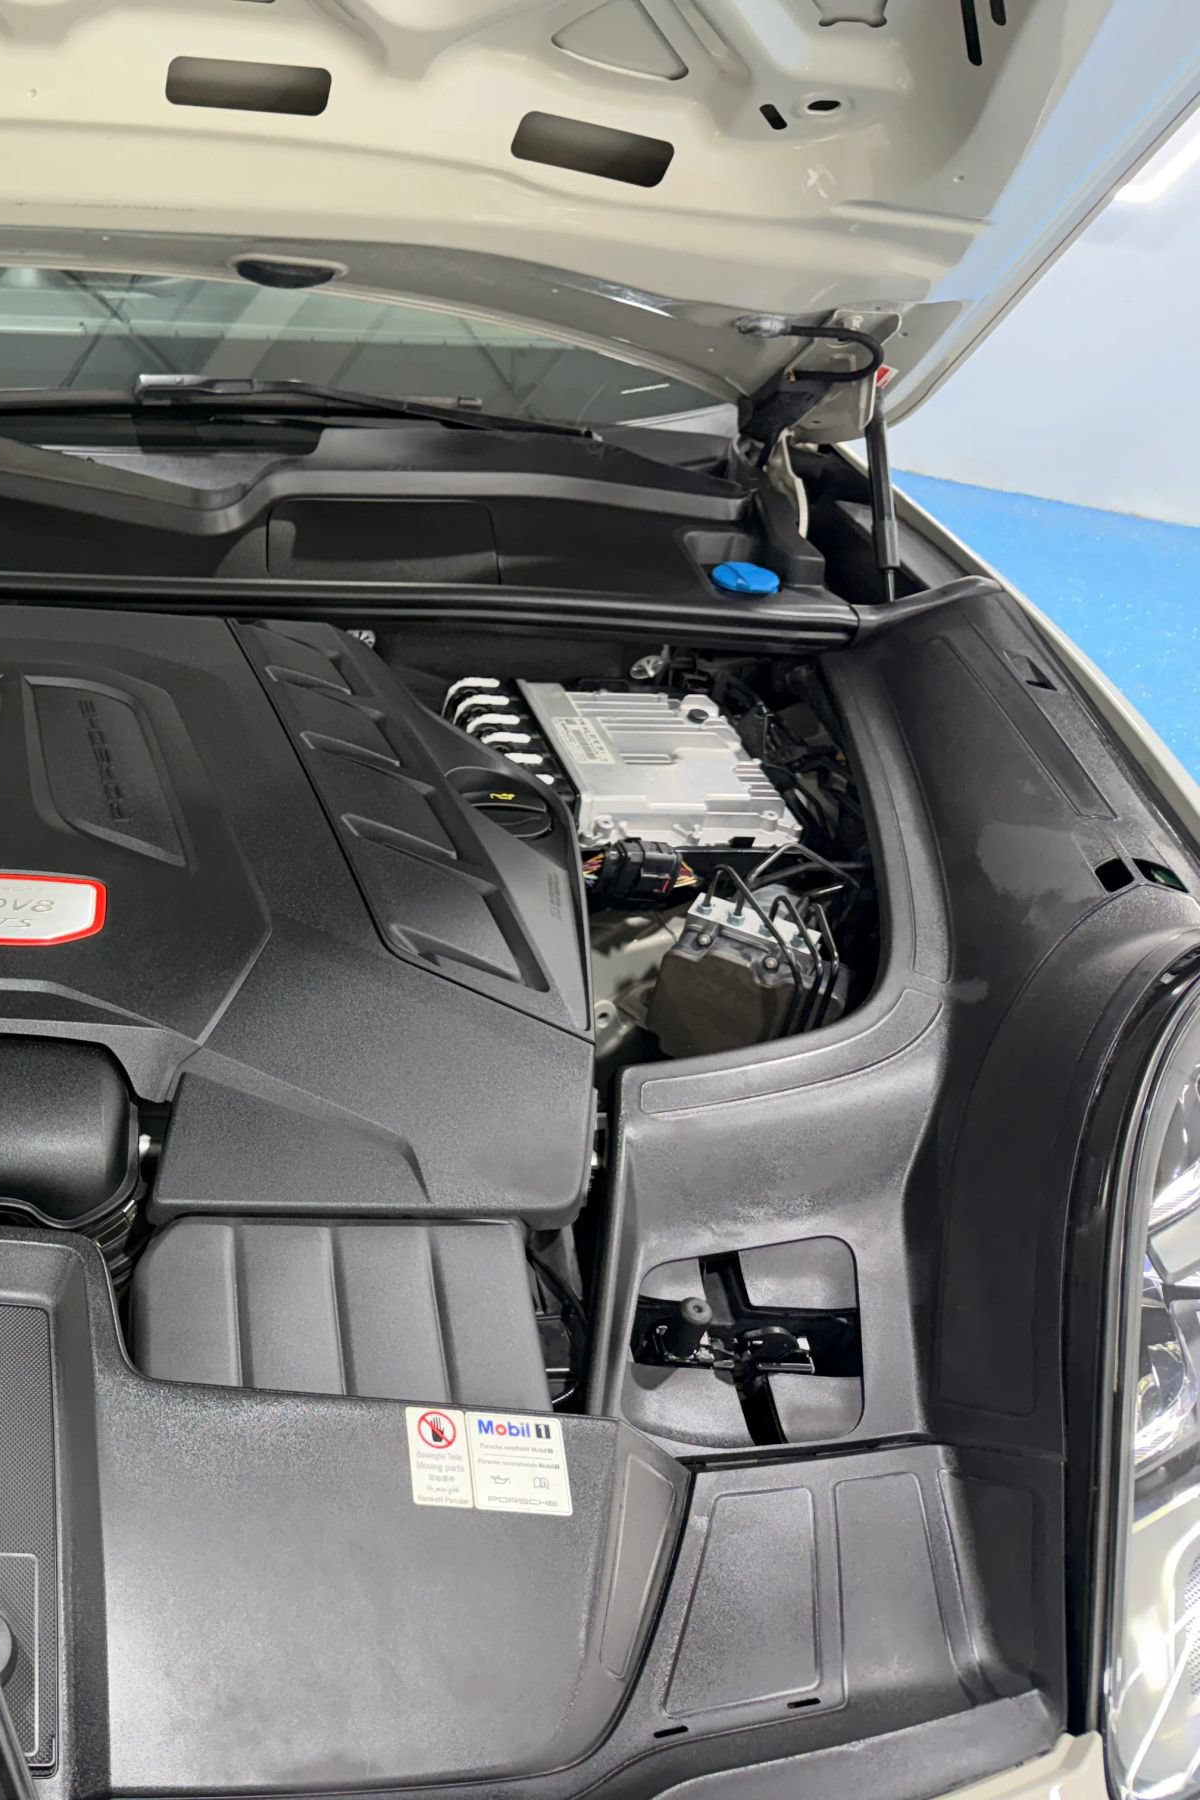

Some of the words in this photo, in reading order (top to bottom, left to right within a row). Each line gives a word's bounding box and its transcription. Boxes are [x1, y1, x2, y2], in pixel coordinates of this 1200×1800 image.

[78, 699, 130, 822] PORSCHE
[477, 1418, 531, 1438] Mobil
[536, 1424, 550, 1439] 1
[479, 1442, 503, 1450] Porsche
[416, 1450, 445, 1461] Bewegte
[416, 1460, 443, 1473] Moving
[445, 1463, 465, 1473] parts
[487, 1495, 559, 1507] PORSCHE
